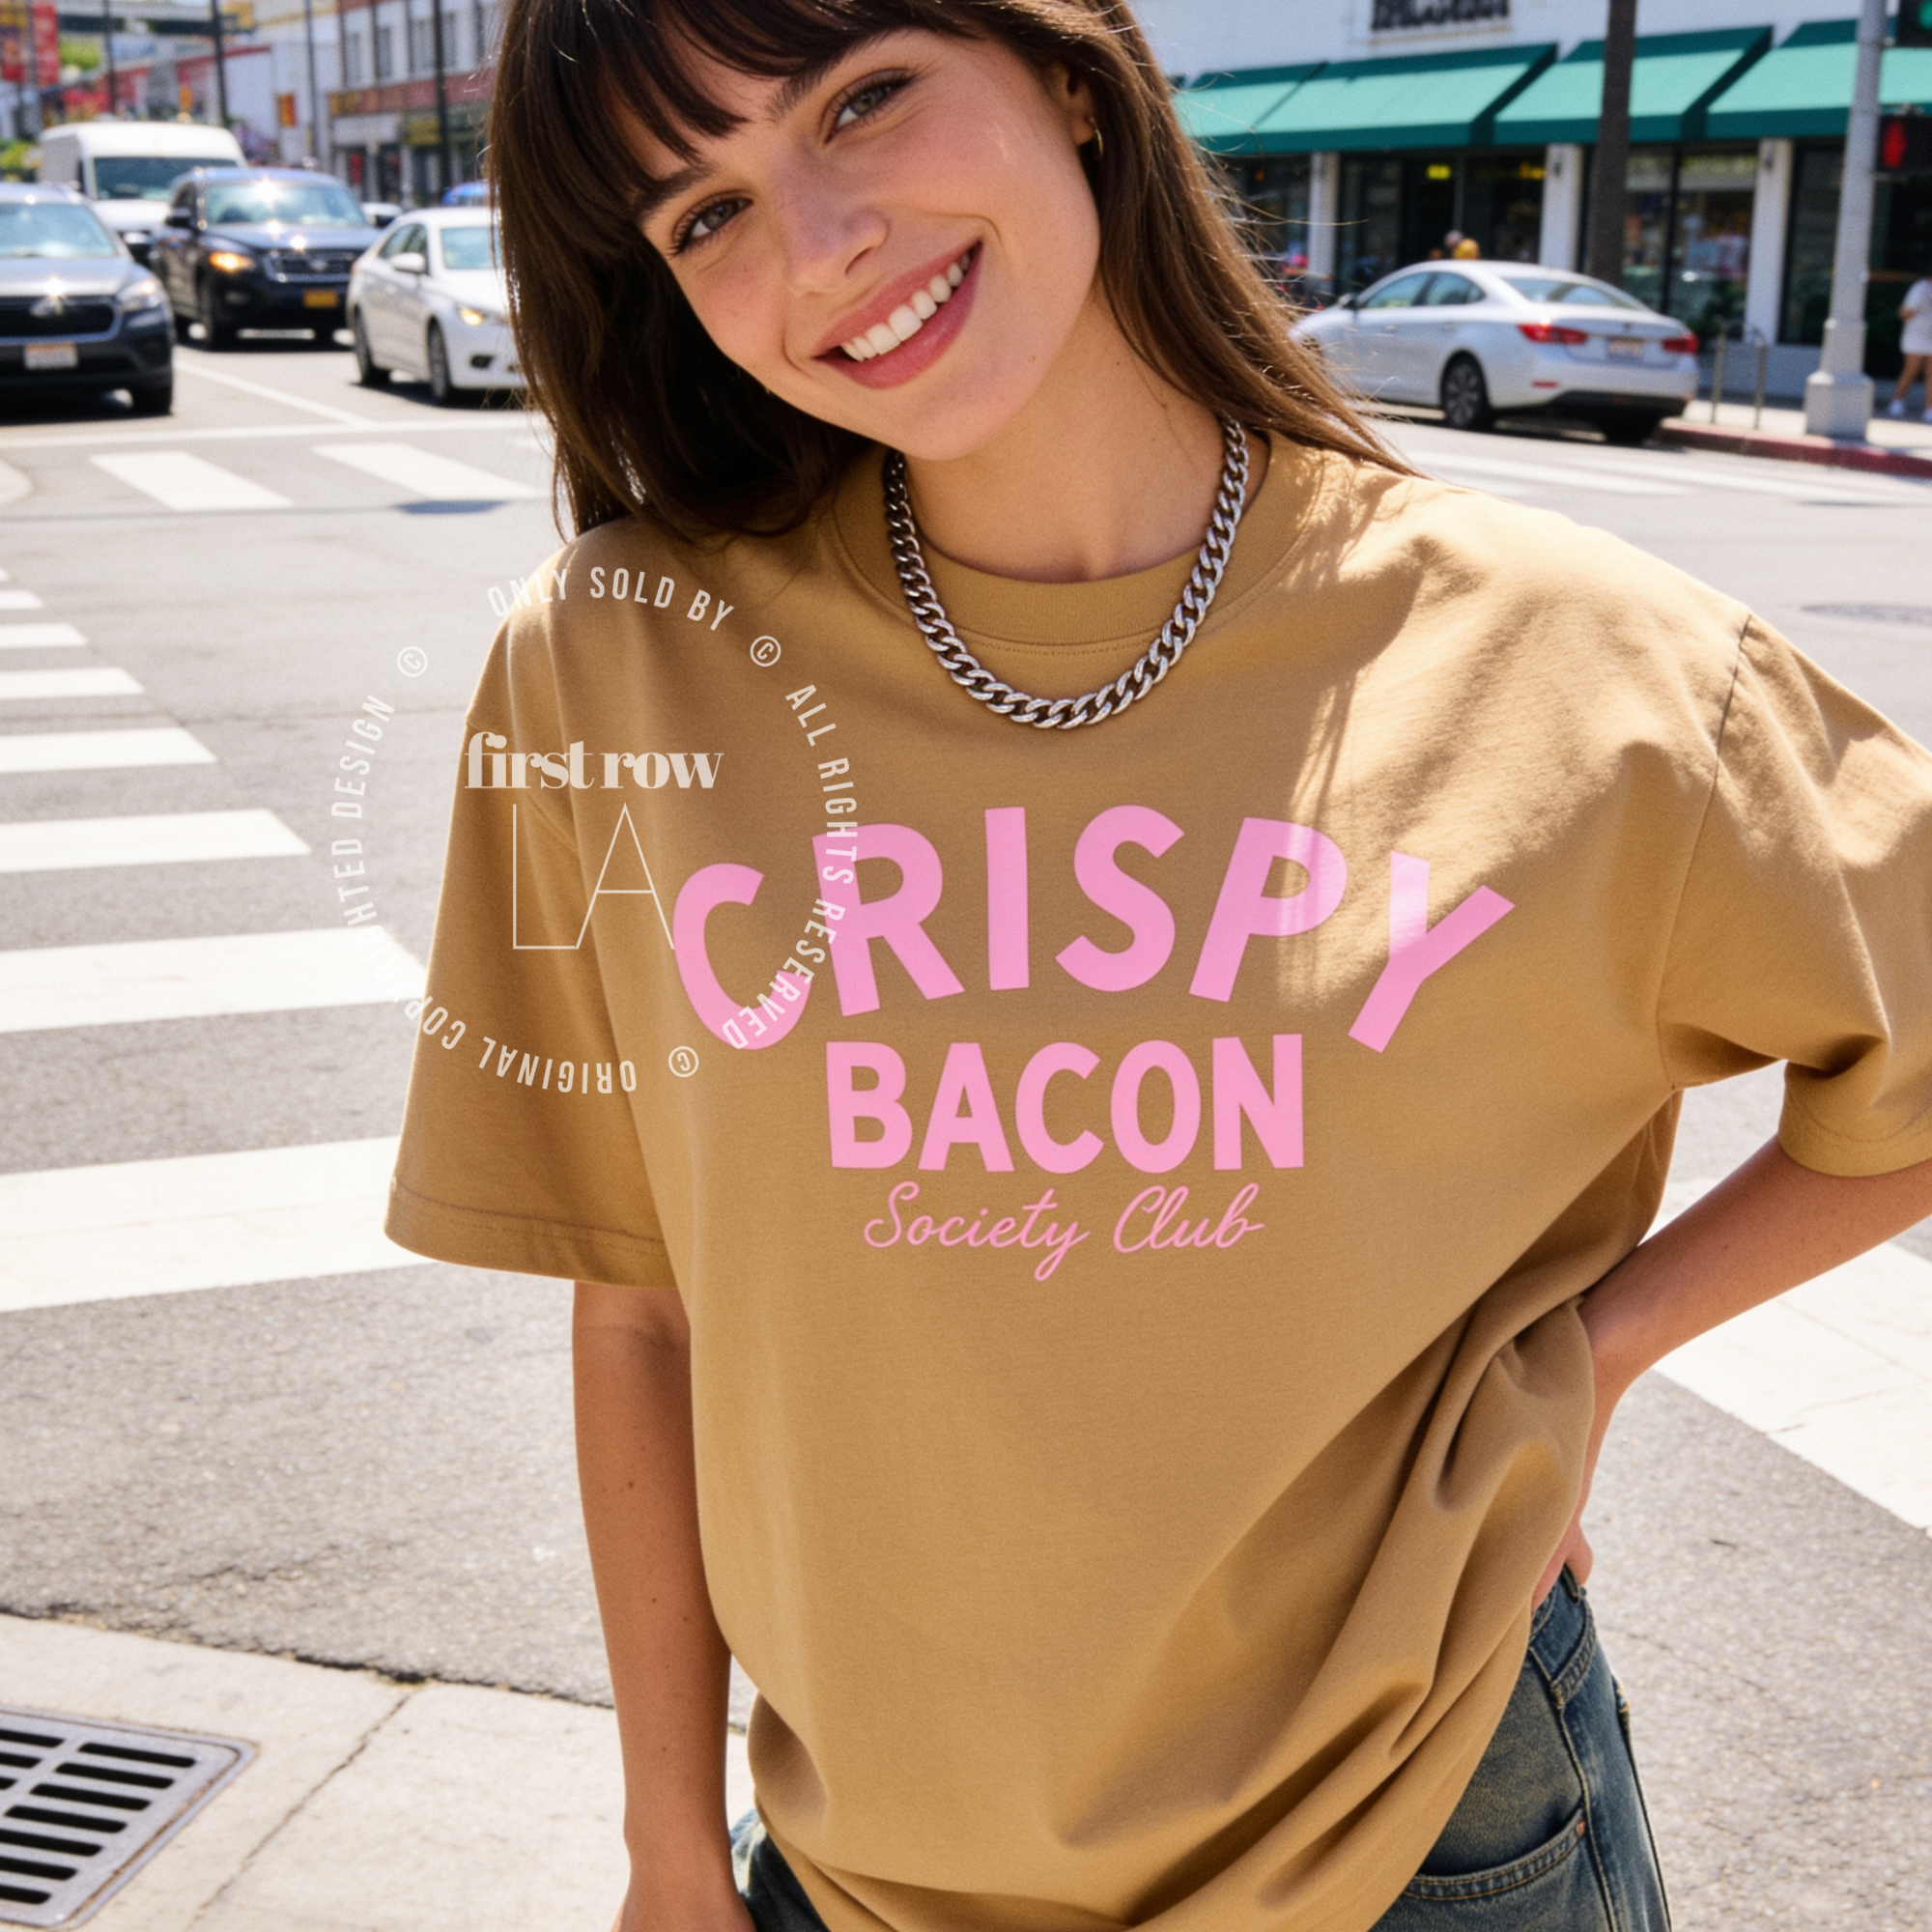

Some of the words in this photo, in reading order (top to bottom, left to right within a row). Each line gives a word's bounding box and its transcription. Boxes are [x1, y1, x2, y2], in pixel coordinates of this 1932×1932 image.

[673, 805, 1516, 1054] CRISPY
[825, 1034, 1304, 1175] BACON
[863, 1180, 1091, 1282] Society
[1111, 1182, 1264, 1254] Club
